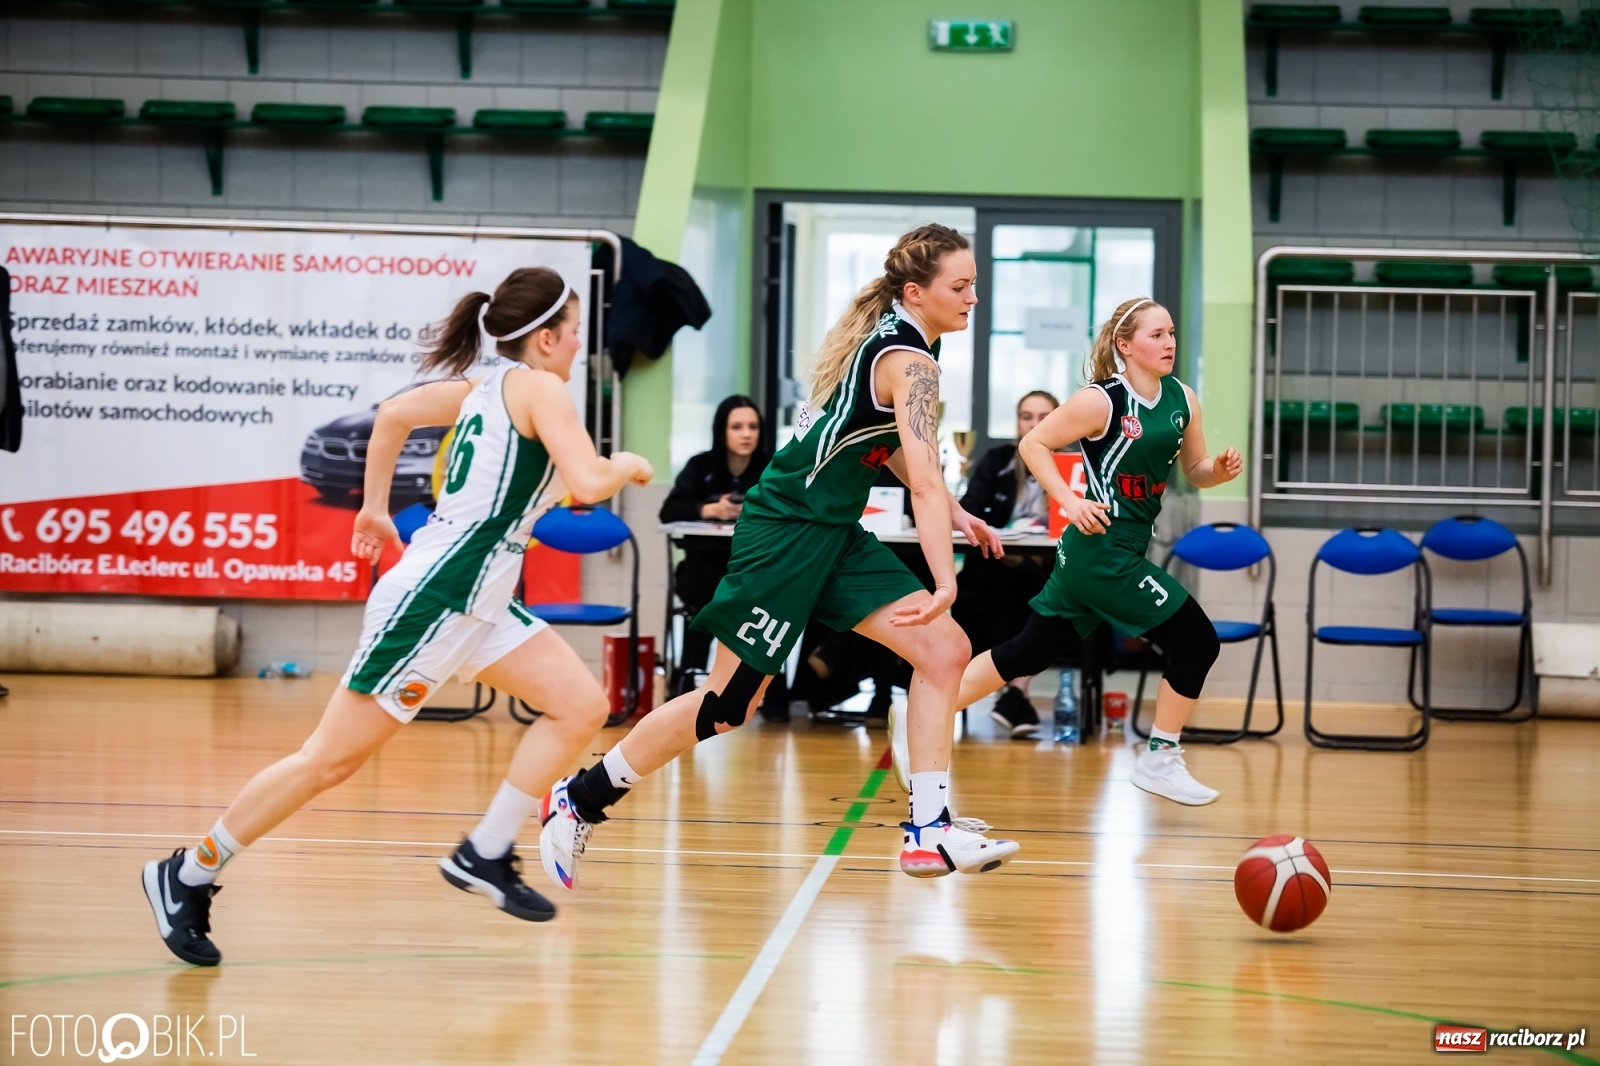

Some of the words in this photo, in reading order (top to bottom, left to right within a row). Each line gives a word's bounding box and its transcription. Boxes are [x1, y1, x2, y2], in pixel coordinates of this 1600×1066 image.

[6, 246, 132, 267] AWARYJNE
[139, 250, 285, 272] OTWIERANIE
[293, 253, 476, 277] SAMOCHODÓW
[10, 275, 69, 295] ORAZ
[76, 275, 200, 298] MIESZKAŃ
[106, 315, 199, 336] zamków,
[205, 316, 284, 338] kłódek,
[289, 320, 380, 340] wkładek
[385, 322, 412, 341] do
[101, 341, 169, 357] również
[175, 344, 239, 360] montaż
[244, 344, 249, 360] i
[254, 349, 328, 364] wymianę
[335, 348, 406, 364] zamków
[19, 371, 118, 391] orabianie
[124, 377, 168, 393] oraz
[173, 374, 286, 396] kodowanie
[292, 378, 359, 401] kluczy
[99, 402, 274, 426] samochodowych
[36, 507, 112, 545] 695
[121, 510, 195, 548] 496
[203, 512, 279, 550] 555
[0, 553, 93, 576] Racibórz
[97, 555, 191, 579] E.Leclerc
[193, 557, 221, 580] ul.
[223, 559, 324, 584] Opawska
[326, 560, 357, 583] 45
[1138, 575, 1169, 607] 3
[736, 606, 791, 658] 24
